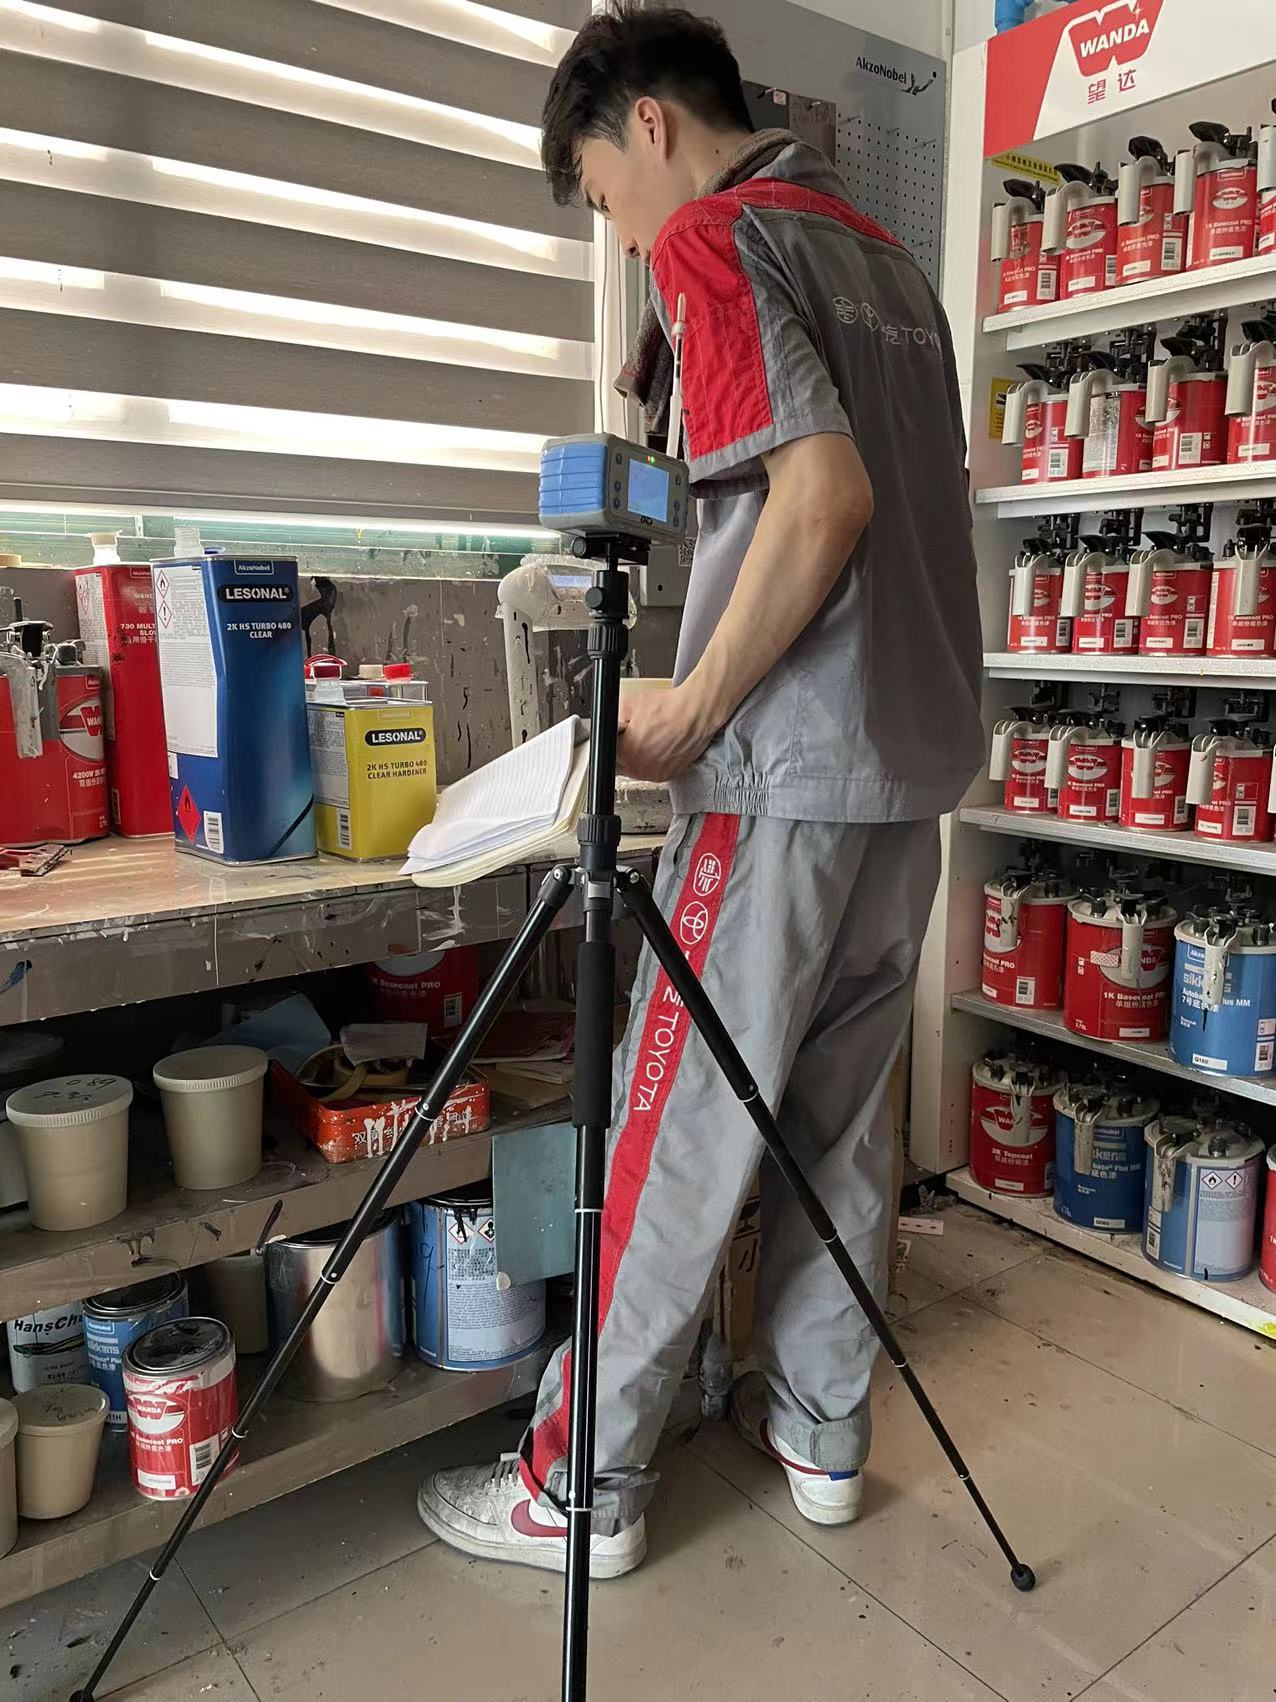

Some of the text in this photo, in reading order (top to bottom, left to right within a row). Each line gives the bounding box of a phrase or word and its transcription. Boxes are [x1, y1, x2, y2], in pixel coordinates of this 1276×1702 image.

[1080, 17, 1150, 58] WANDA
[855, 56, 907, 85] AkzoNobel
[1087, 69, 1137, 105] 望达
[225, 587, 287, 600] LESONAL
[227, 622, 292, 631] 2K HS TURBO 480
[249, 631, 273, 639] CLEAR
[371, 731, 421, 744] LESONAL
[366, 764, 377, 772] 2K
[378, 763, 389, 771] HS
[390, 761, 414, 769] TURBO
[367, 768, 427, 780] CLEAR HARDENER
[1000, 959, 1015, 969] PRO
[420, 981, 441, 989] PRO
[1103, 991, 1115, 999] 1K
[1117, 992, 1154, 1001] Basecoat
[1235, 998, 1251, 1007] MM
[634, 1012, 679, 1112] TOYOTA
[1003, 1150, 1033, 1160] Topcoat
[137, 1404, 162, 1414] WANDA
[166, 1437, 184, 1446] PRO
